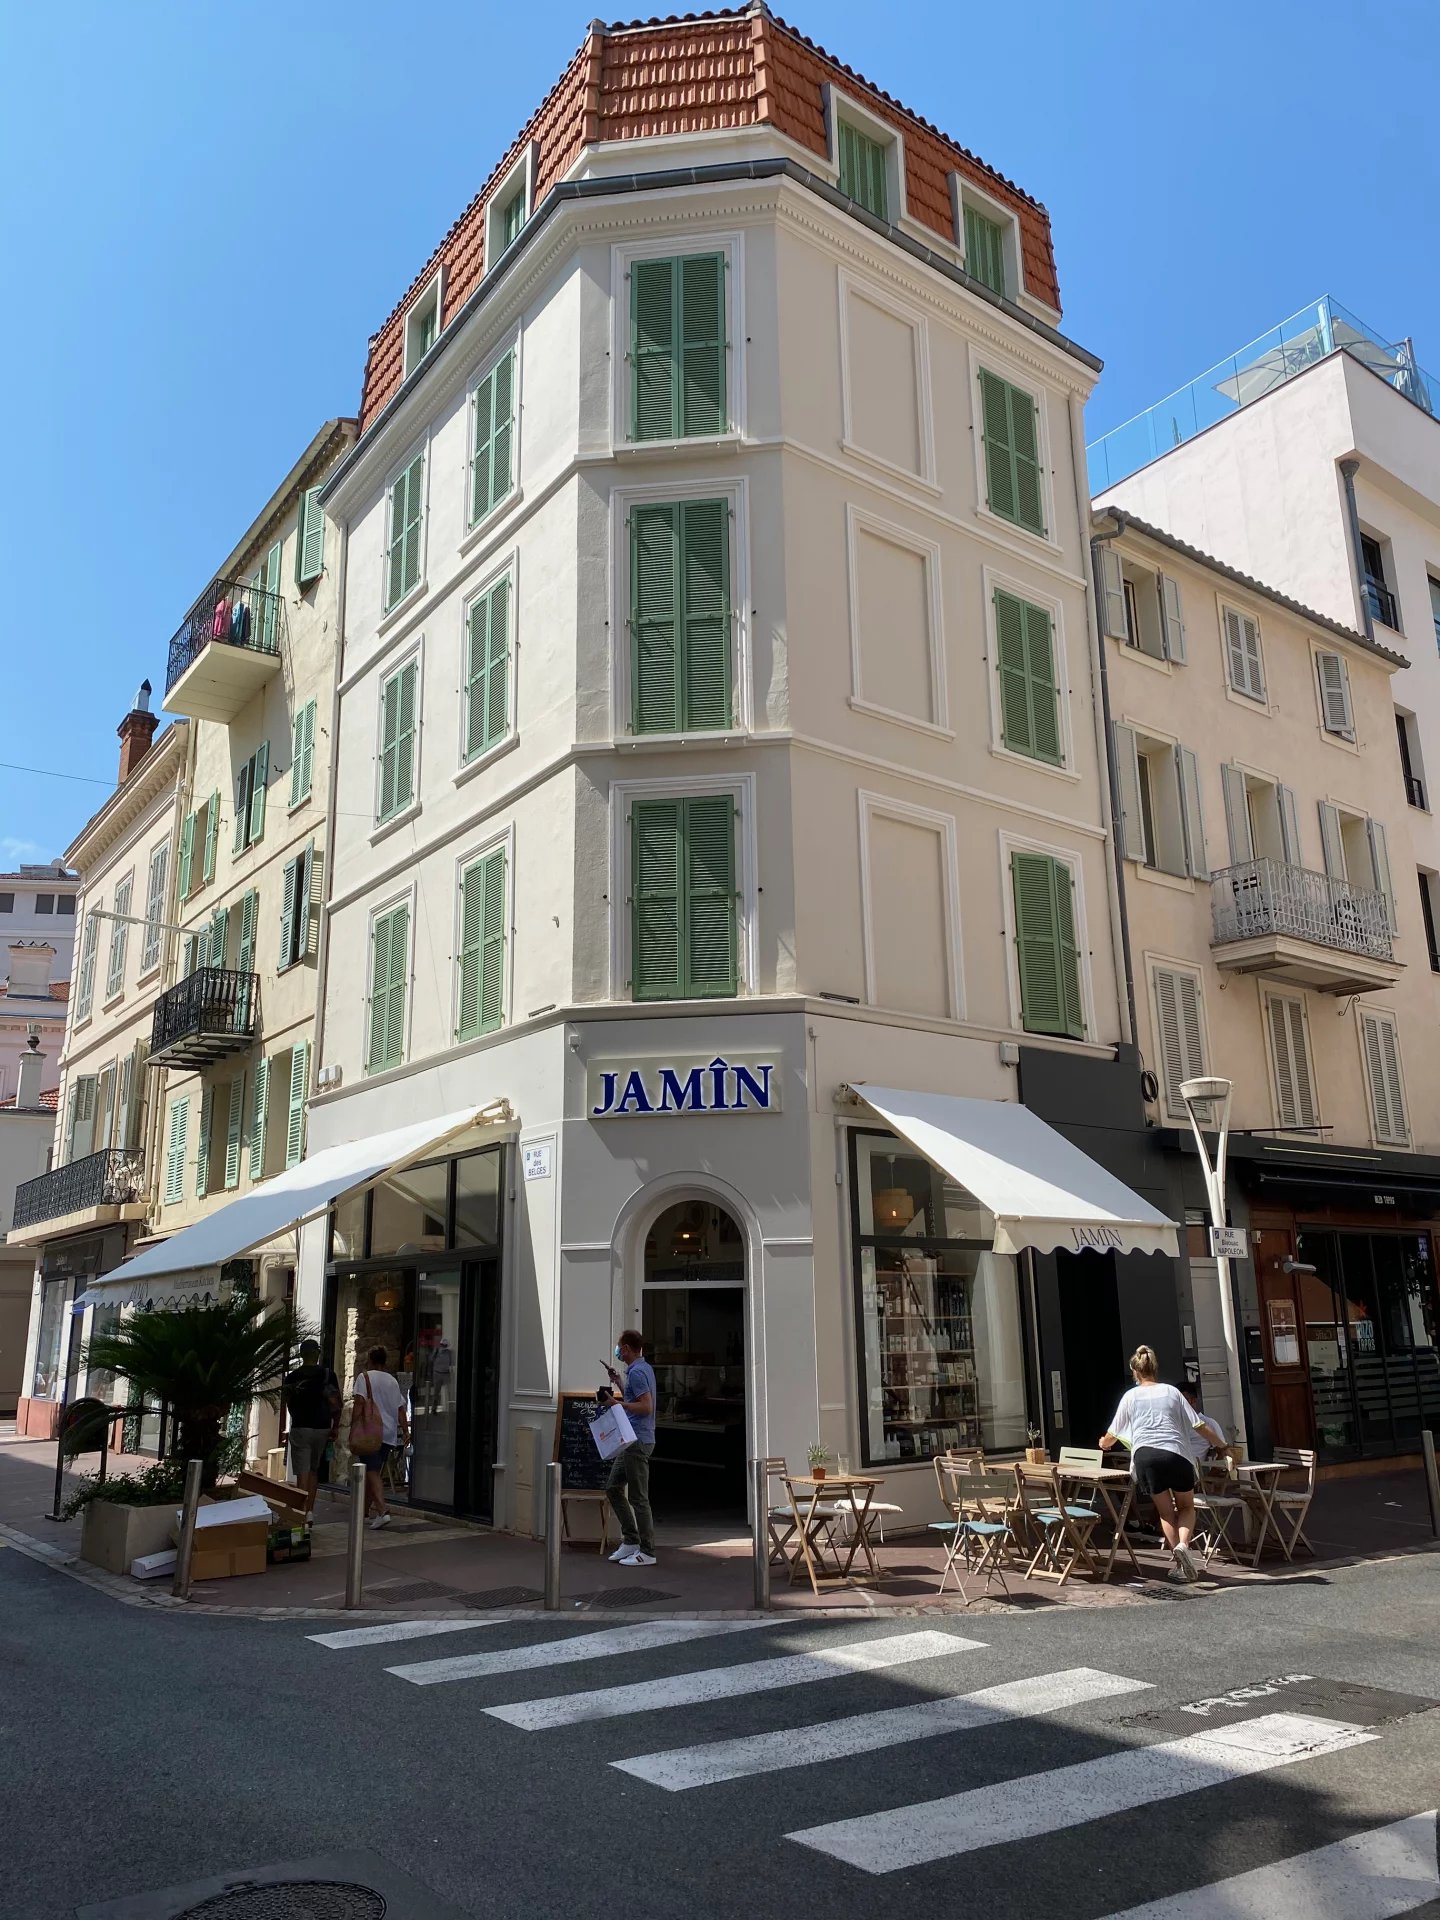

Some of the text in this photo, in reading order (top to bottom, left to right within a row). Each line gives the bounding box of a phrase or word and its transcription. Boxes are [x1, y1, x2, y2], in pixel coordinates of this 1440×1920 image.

[593, 1056, 773, 1115] JAMÎN
[533, 1150, 542, 1158] RUE
[528, 1166, 546, 1176] BELGES
[1071, 1225, 1124, 1251] JAMÎN
